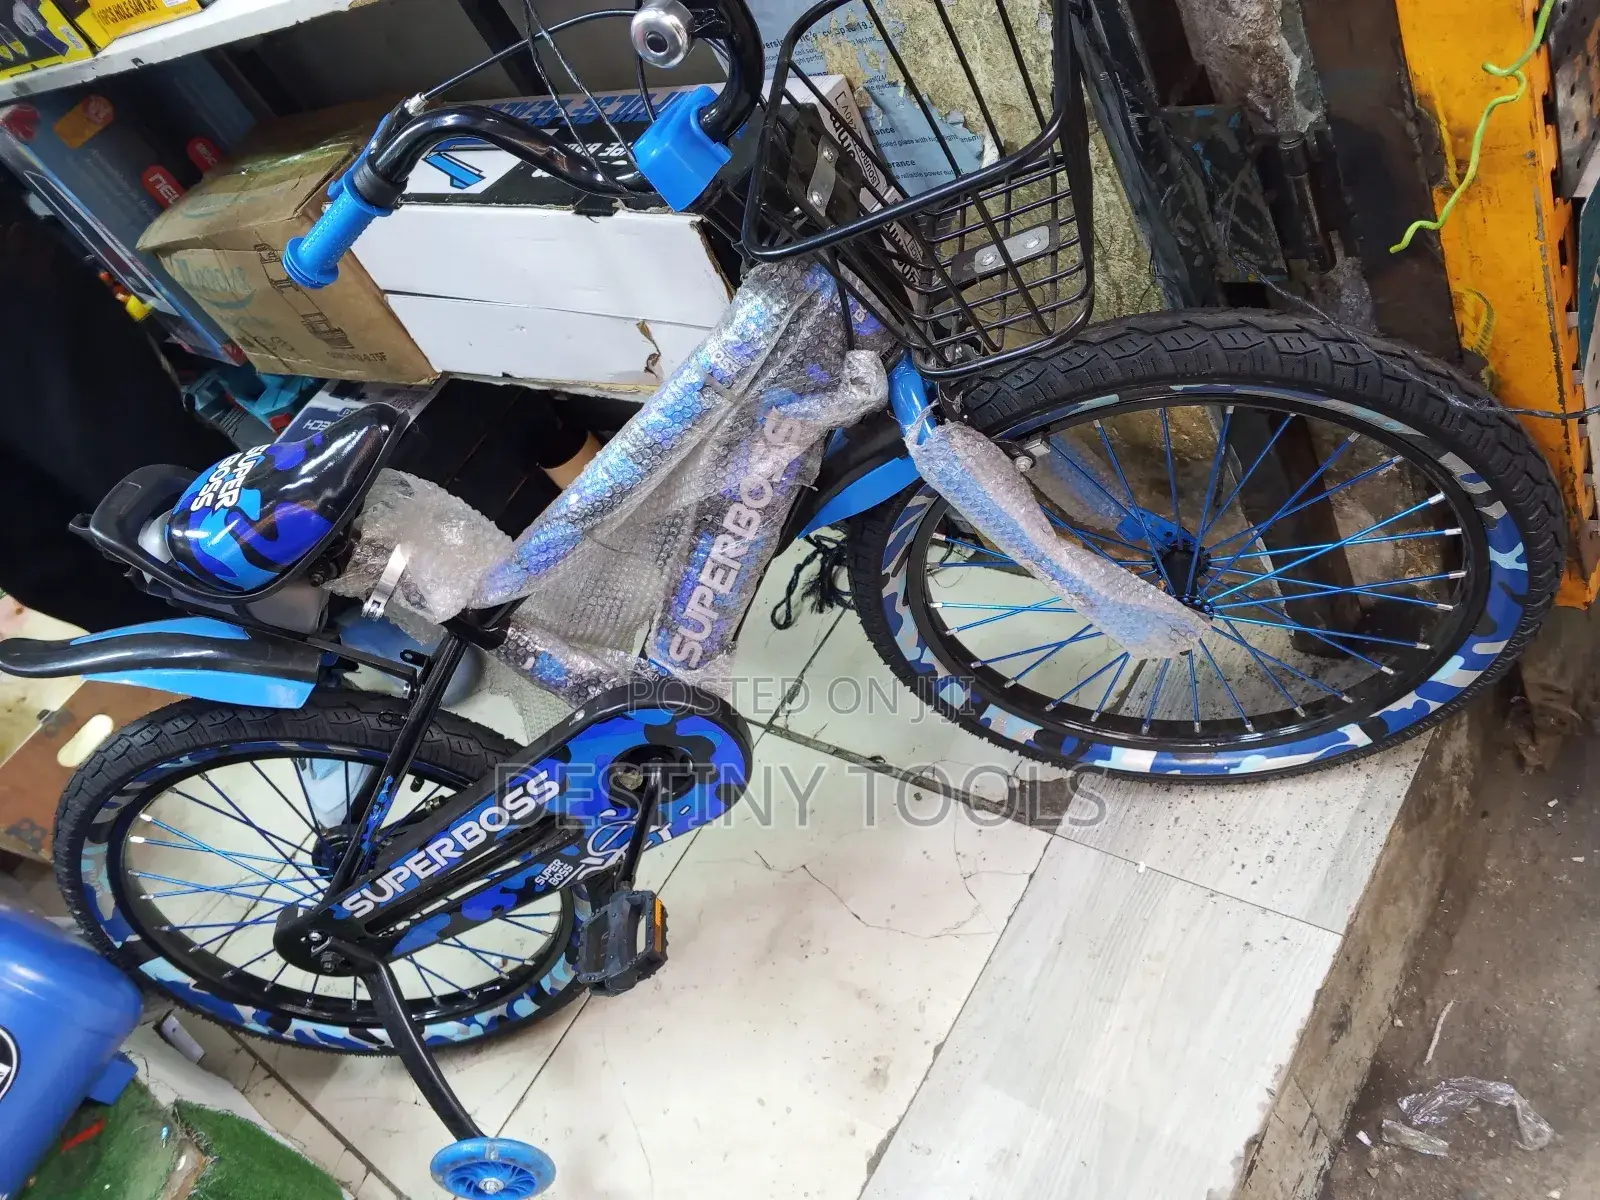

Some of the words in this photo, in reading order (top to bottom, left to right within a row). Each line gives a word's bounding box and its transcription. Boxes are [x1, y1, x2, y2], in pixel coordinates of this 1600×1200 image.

[190, 452, 243, 512] BOSS
[215, 444, 271, 511] SUPER
[341, 769, 561, 919] SUPERBOSS
[534, 858, 565, 887] SUPER
[548, 863, 574, 890] BOSS
